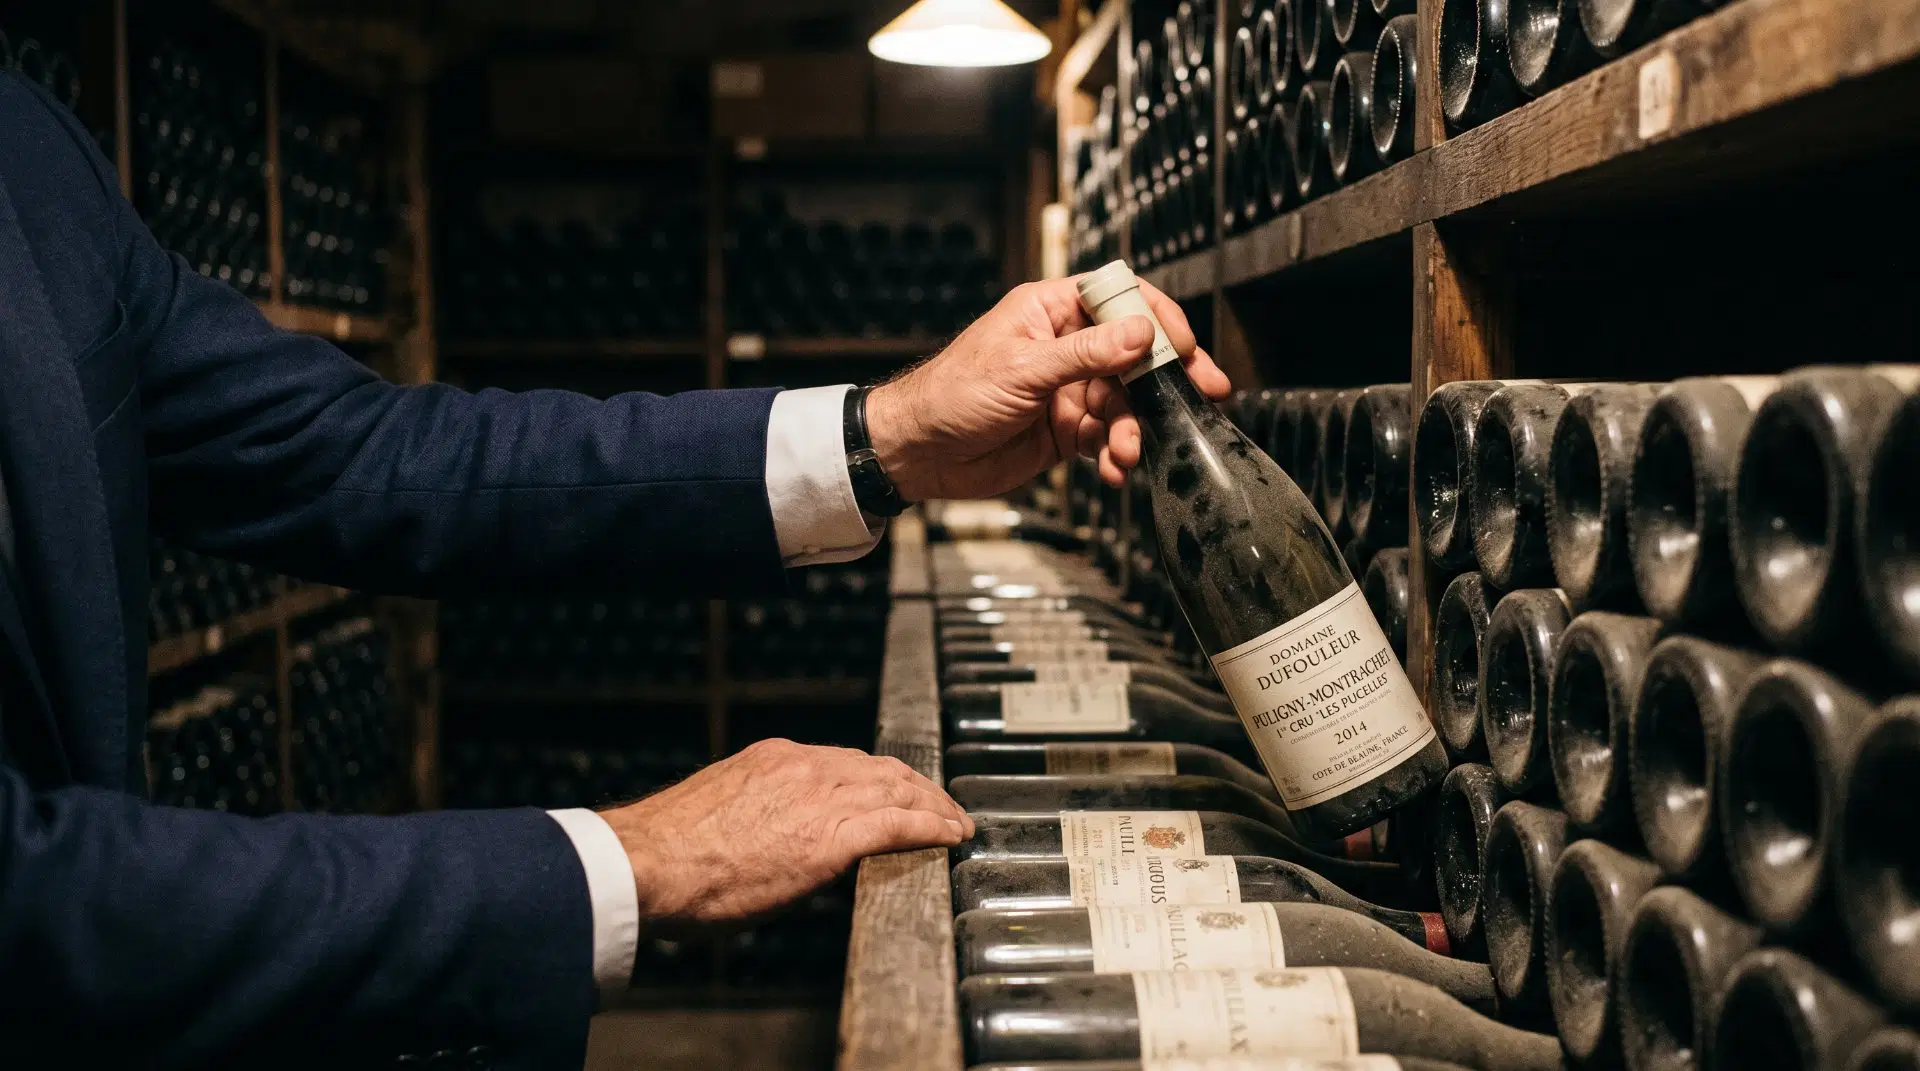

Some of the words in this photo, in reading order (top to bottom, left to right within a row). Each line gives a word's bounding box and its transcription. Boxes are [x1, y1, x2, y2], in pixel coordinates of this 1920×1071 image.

[1256, 629, 1360, 690] DUFOULEUR
[1269, 624, 1335, 665] DOMAINE
[1252, 647, 1391, 728] PULIGNY-MONTRACHET
[1288, 714, 1313, 732] CRU
[1333, 720, 1367, 744] 2014
[1333, 760, 1347, 771] DE
[1382, 725, 1408, 745] FRANCE
